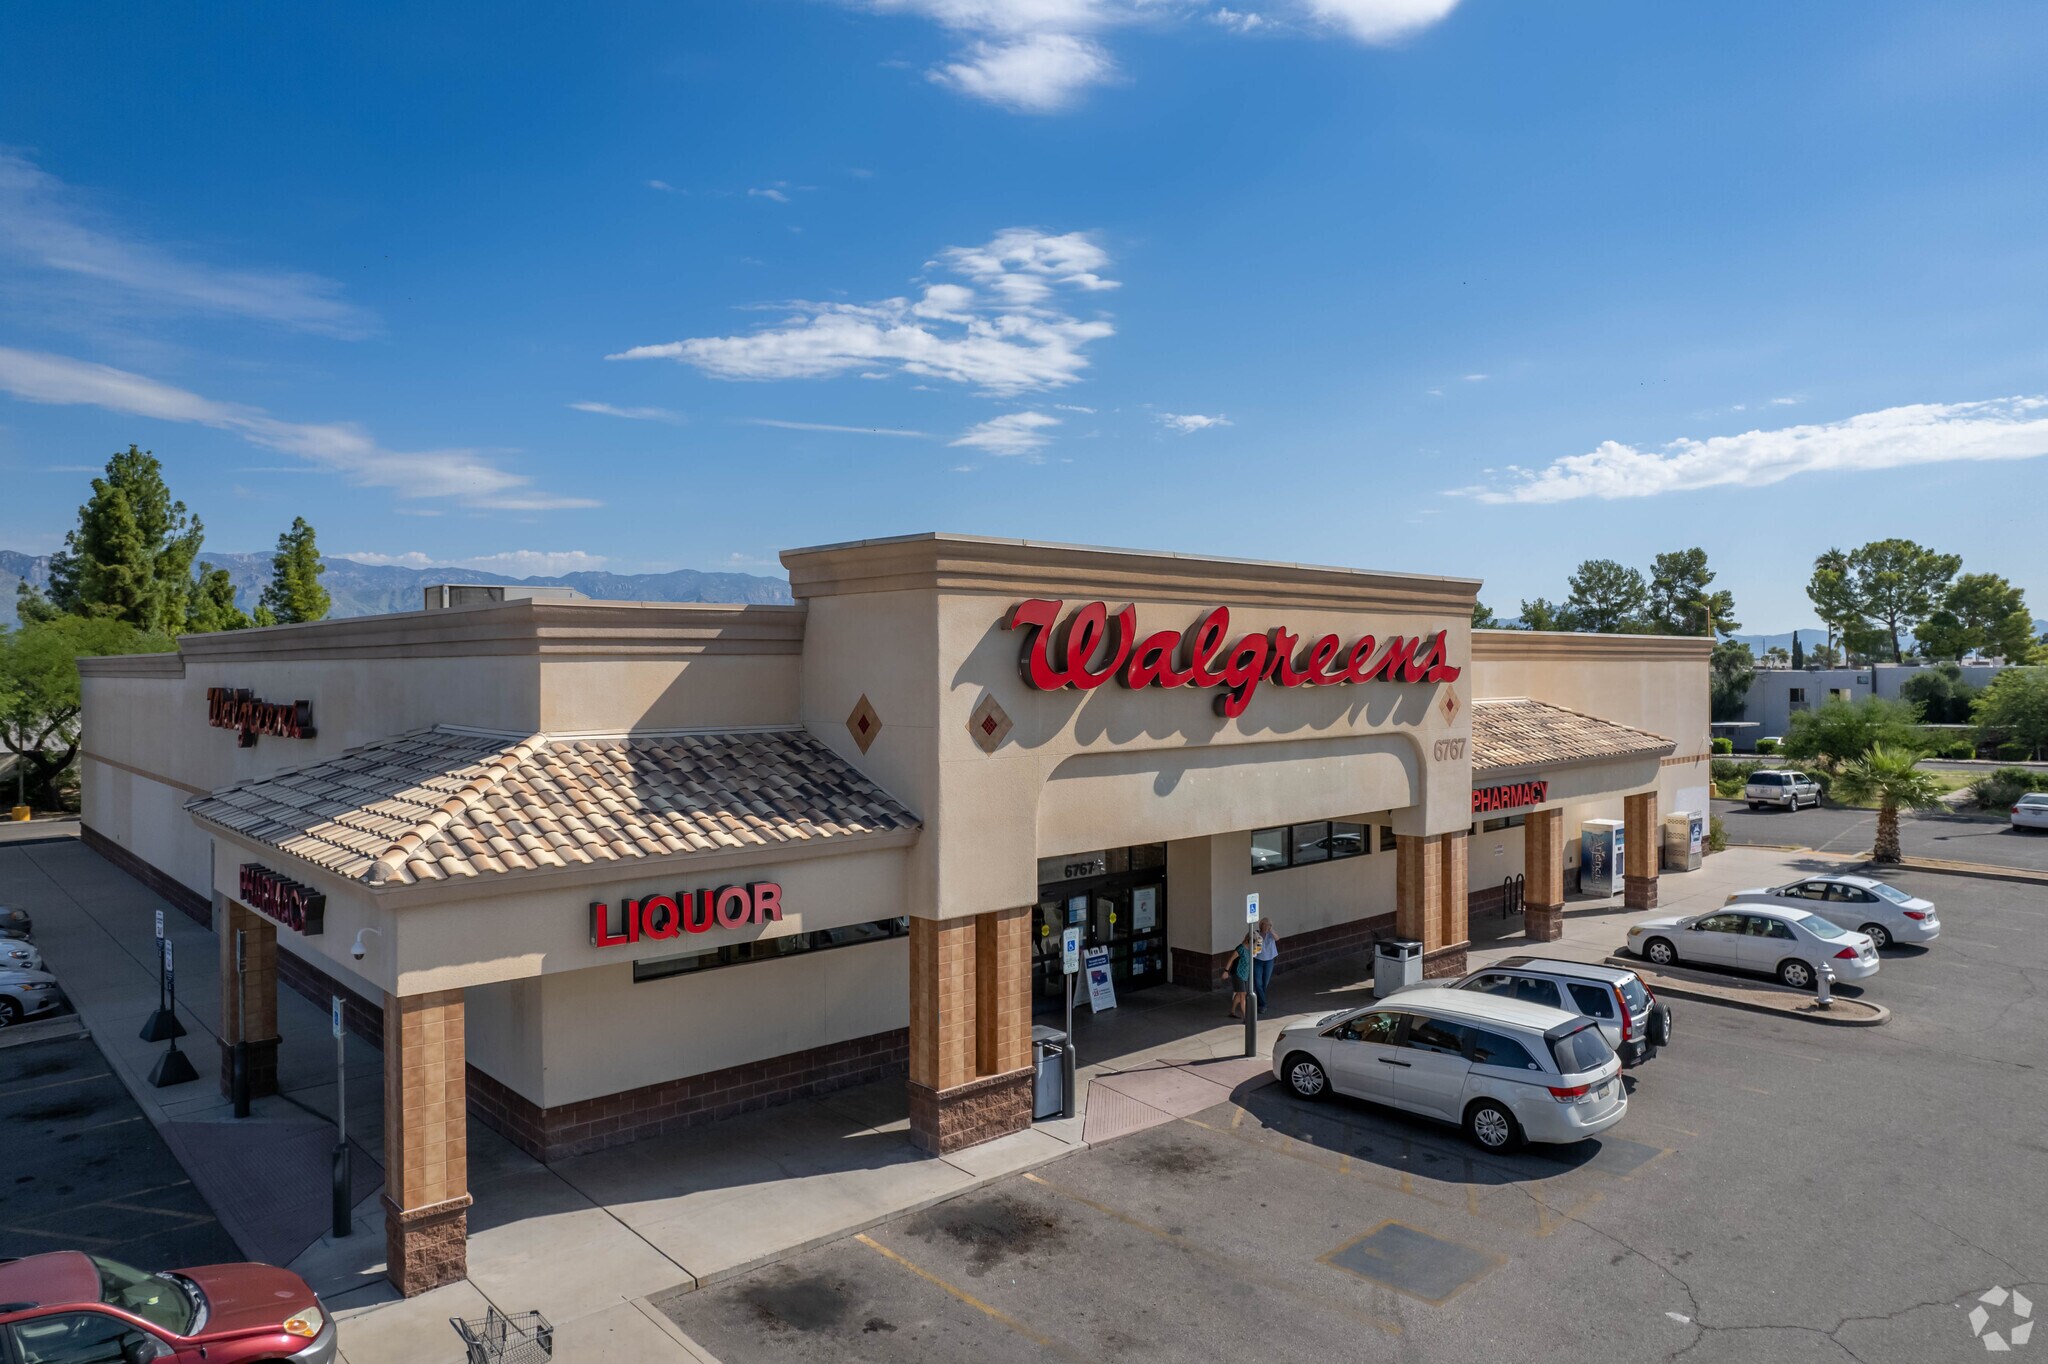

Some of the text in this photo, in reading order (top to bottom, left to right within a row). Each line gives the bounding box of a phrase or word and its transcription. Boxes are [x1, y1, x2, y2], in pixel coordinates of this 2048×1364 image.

[1001, 599, 1461, 718] Walgreens
[207, 688, 314, 747] Walgreens
[1434, 738, 1466, 761] 6767
[1471, 781, 1549, 814] PHARMACY
[1065, 862, 1095, 878] 6767
[590, 881, 783, 948] LIQUOR
